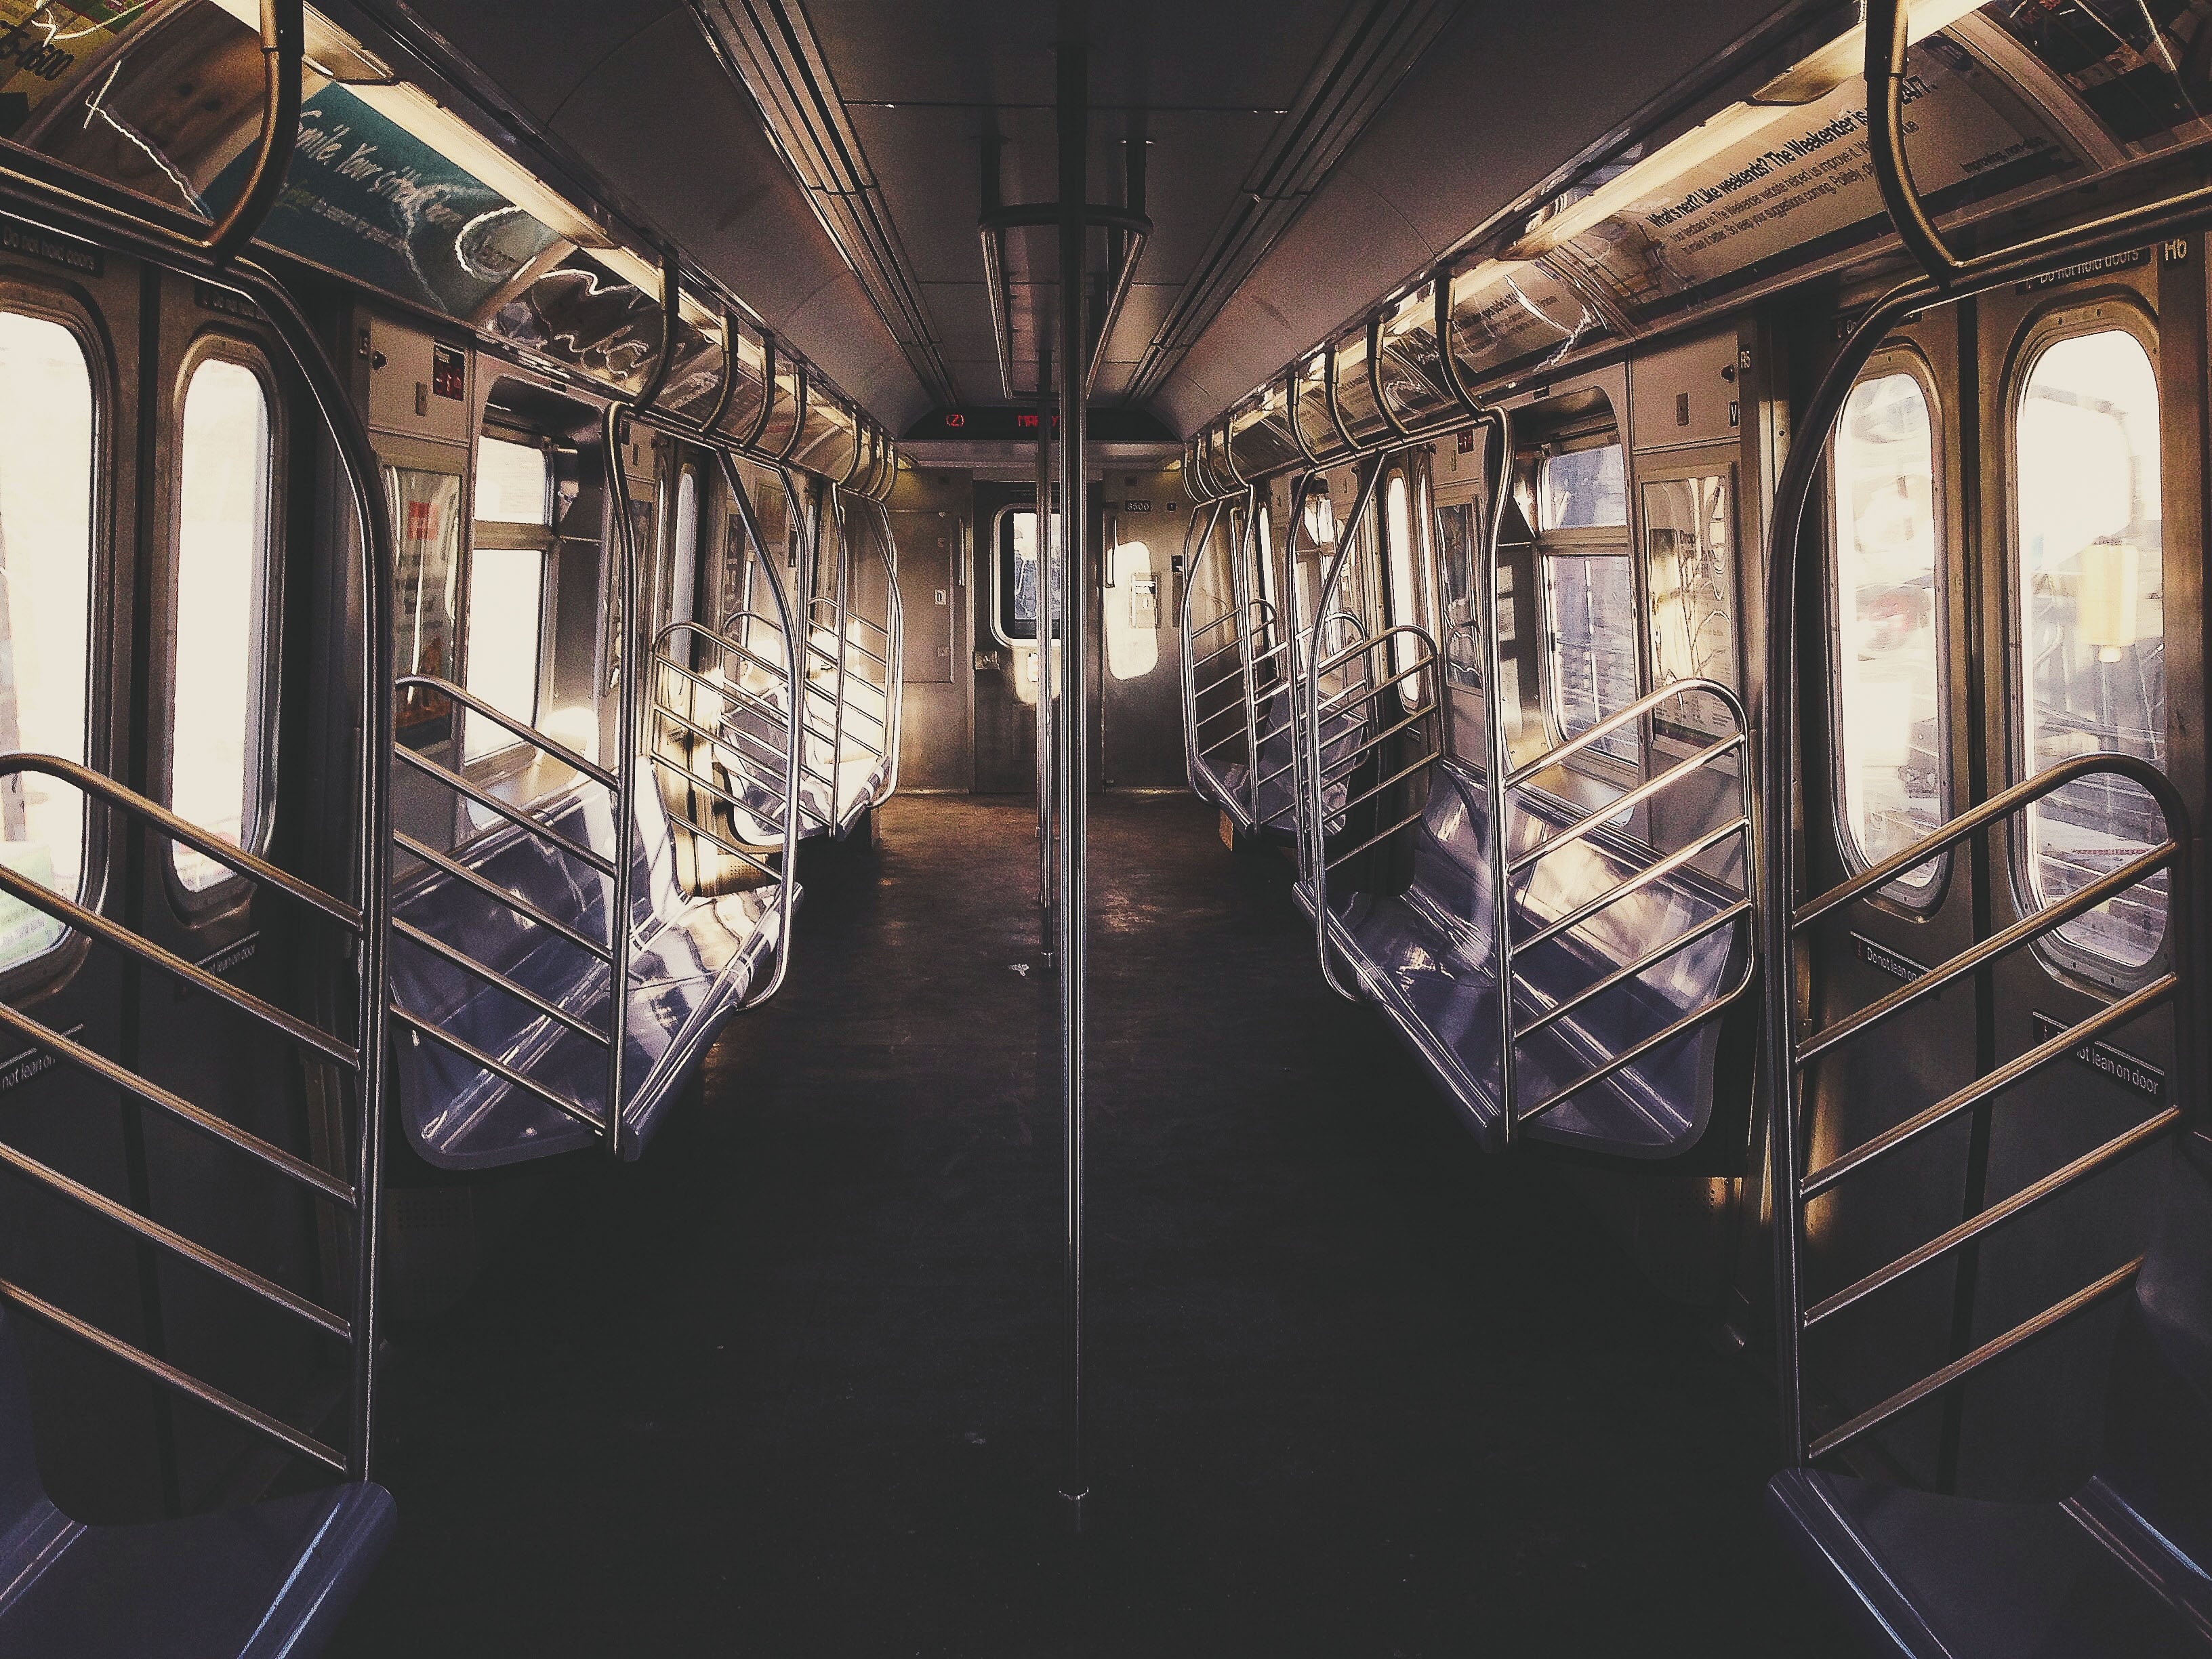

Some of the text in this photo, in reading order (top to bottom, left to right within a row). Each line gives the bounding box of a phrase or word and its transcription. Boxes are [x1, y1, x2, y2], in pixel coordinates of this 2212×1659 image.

[1645, 207, 1682, 228] What's
[1675, 191, 1704, 216] next?
[1697, 186, 1723, 204] Like
[1716, 157, 1774, 194] weekends?
[1763, 150, 1795, 168] The
[1783, 116, 1858, 157] Weekender
[1815, 150, 1853, 171] improve
[1866, 947, 1877, 964] Do
[1878, 956, 1890, 970] not
[1891, 959, 1906, 979] lean
[2092, 1048, 2114, 1074] lean
[2116, 1063, 2130, 1082] on
[2132, 1069, 2158, 1094] door
